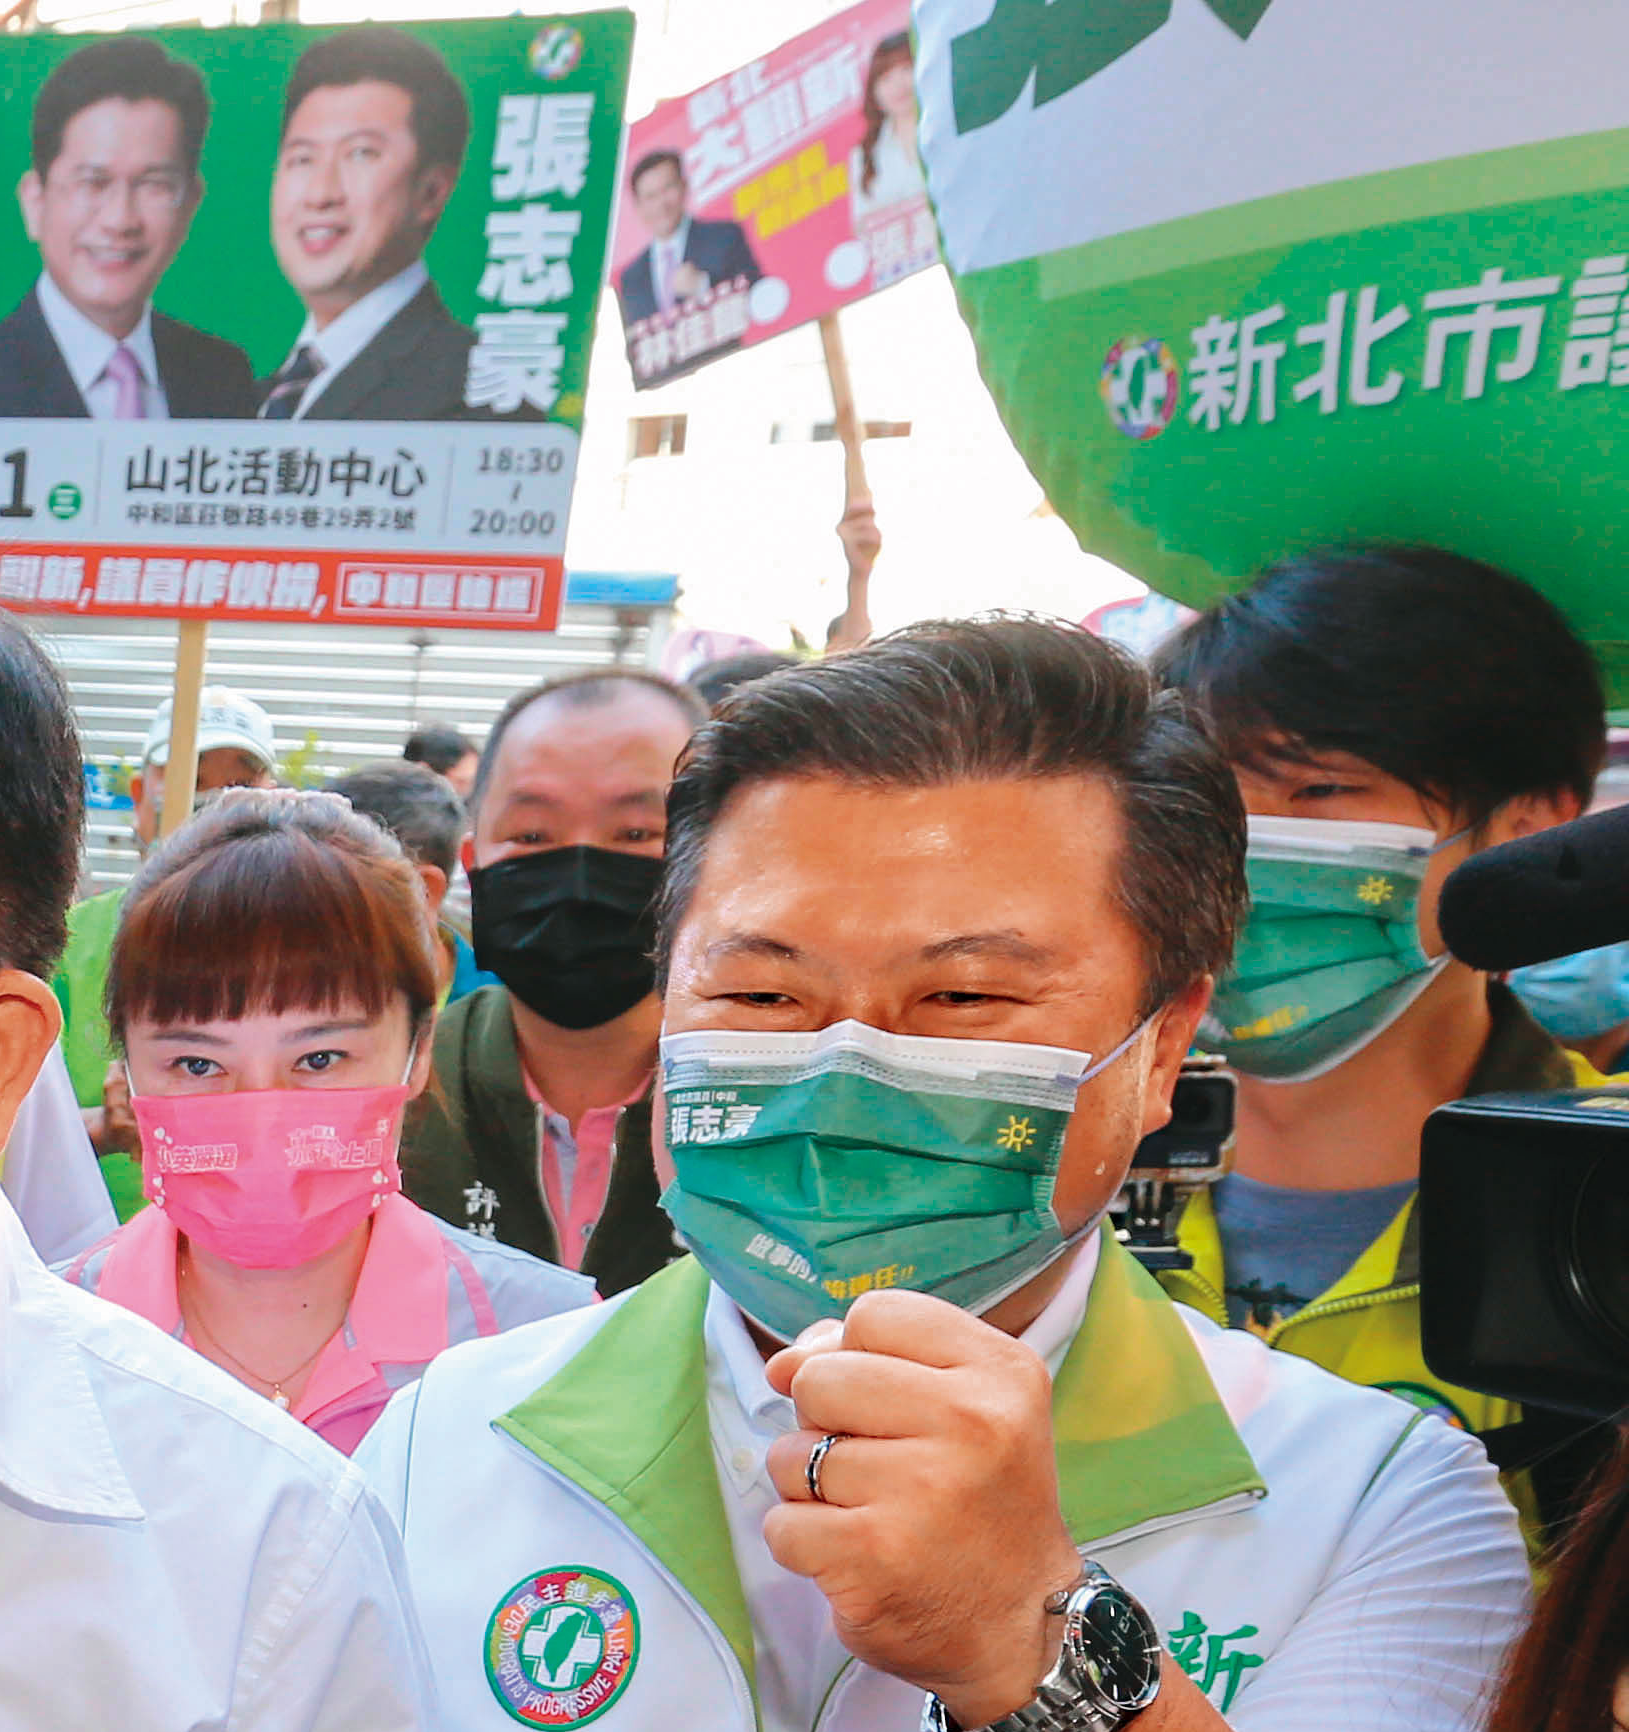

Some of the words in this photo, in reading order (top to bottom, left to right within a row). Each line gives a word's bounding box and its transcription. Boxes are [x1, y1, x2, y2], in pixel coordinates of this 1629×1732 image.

[463, 92, 596, 416] 張志豪
[125, 445, 427, 498] 山北活動中心
[476, 446, 565, 475] 18:30
[469, 509, 557, 536] 20:00
[498, 1606, 528, 1699] DEMOCRATIC
[524, 1675, 613, 1717] PROGRESSIVE
[602, 1626, 629, 1675] PARTY
